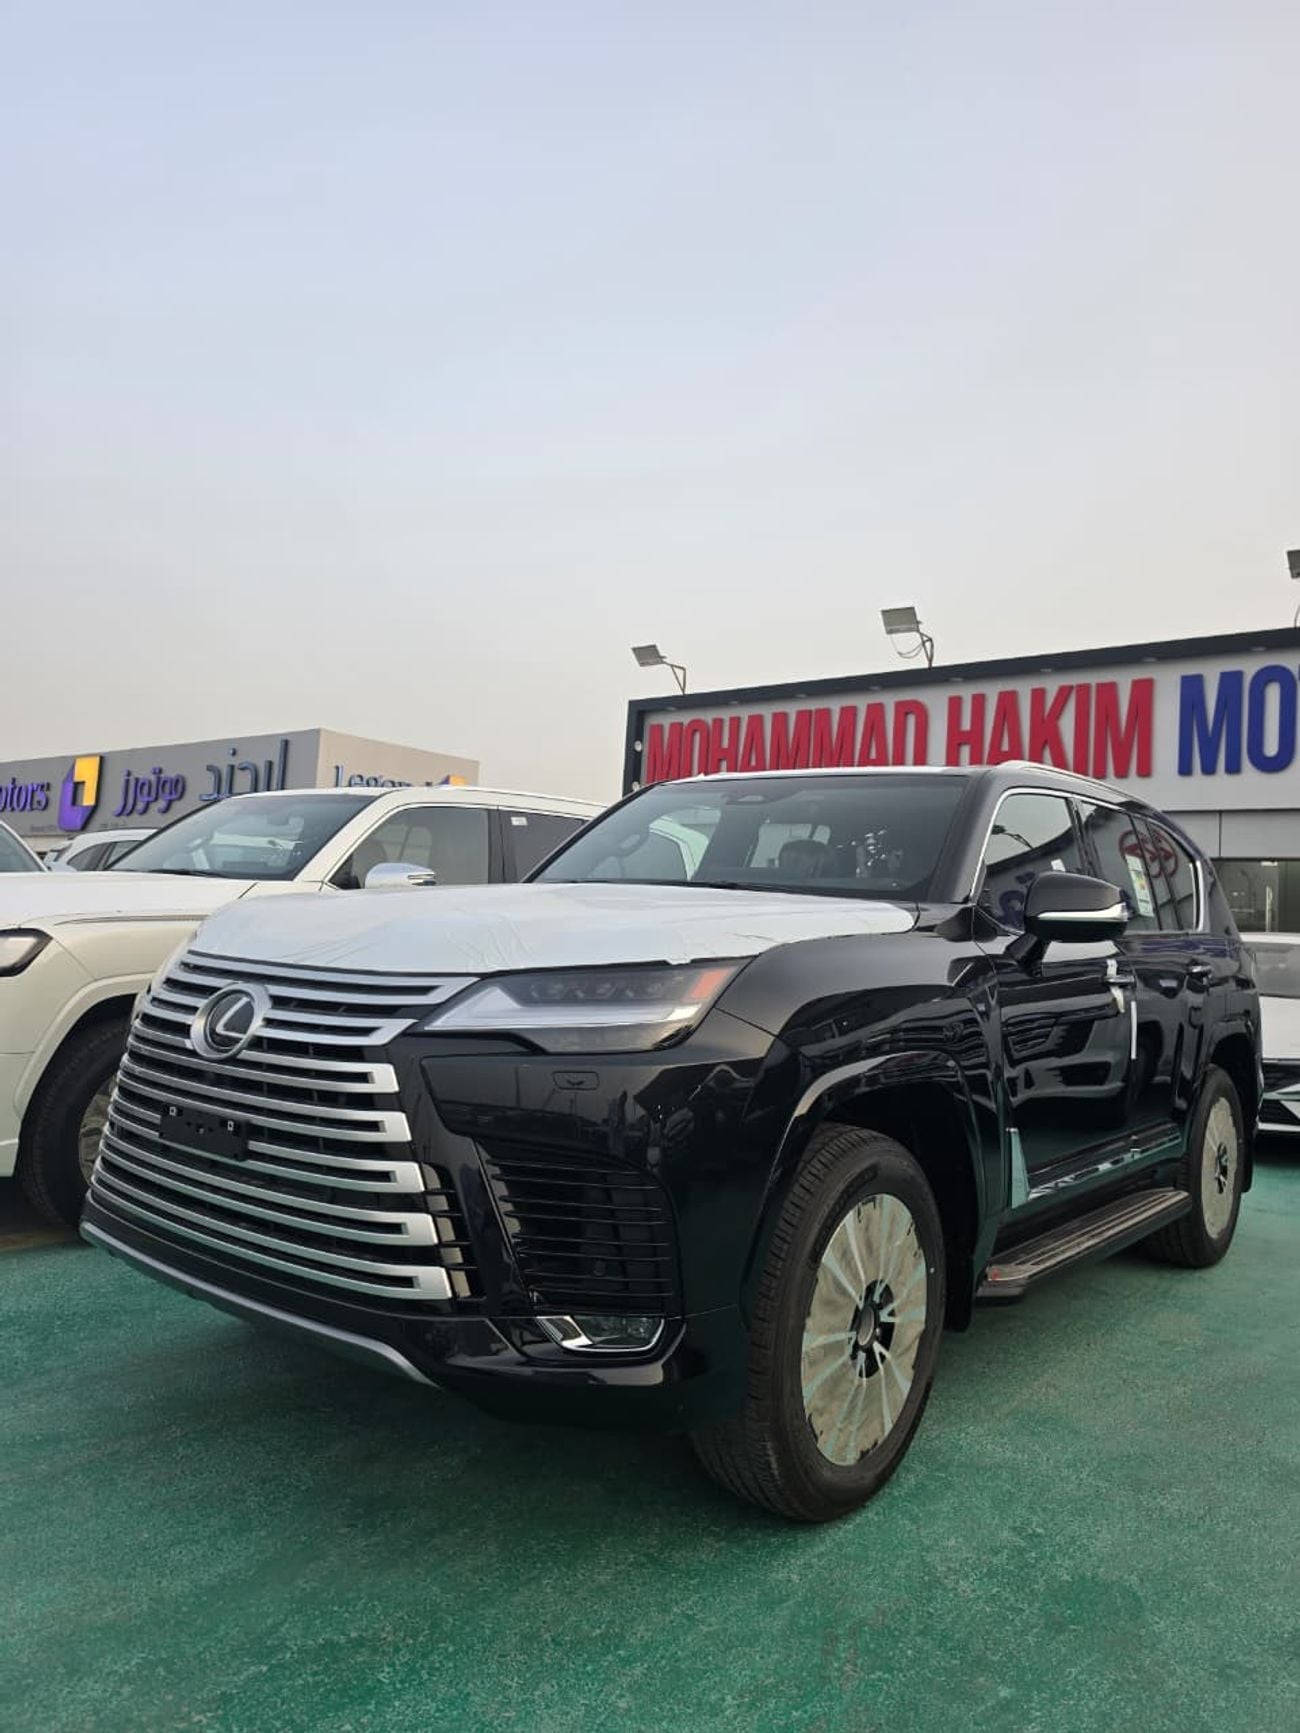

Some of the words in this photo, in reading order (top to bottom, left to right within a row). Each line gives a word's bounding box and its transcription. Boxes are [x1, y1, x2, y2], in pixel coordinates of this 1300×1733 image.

[645, 699, 929, 784] MOHAMMAD
[945, 677, 1155, 779] HAKIM
[1177, 663, 1300, 777] MO
[113, 766, 187, 817] موتورز
